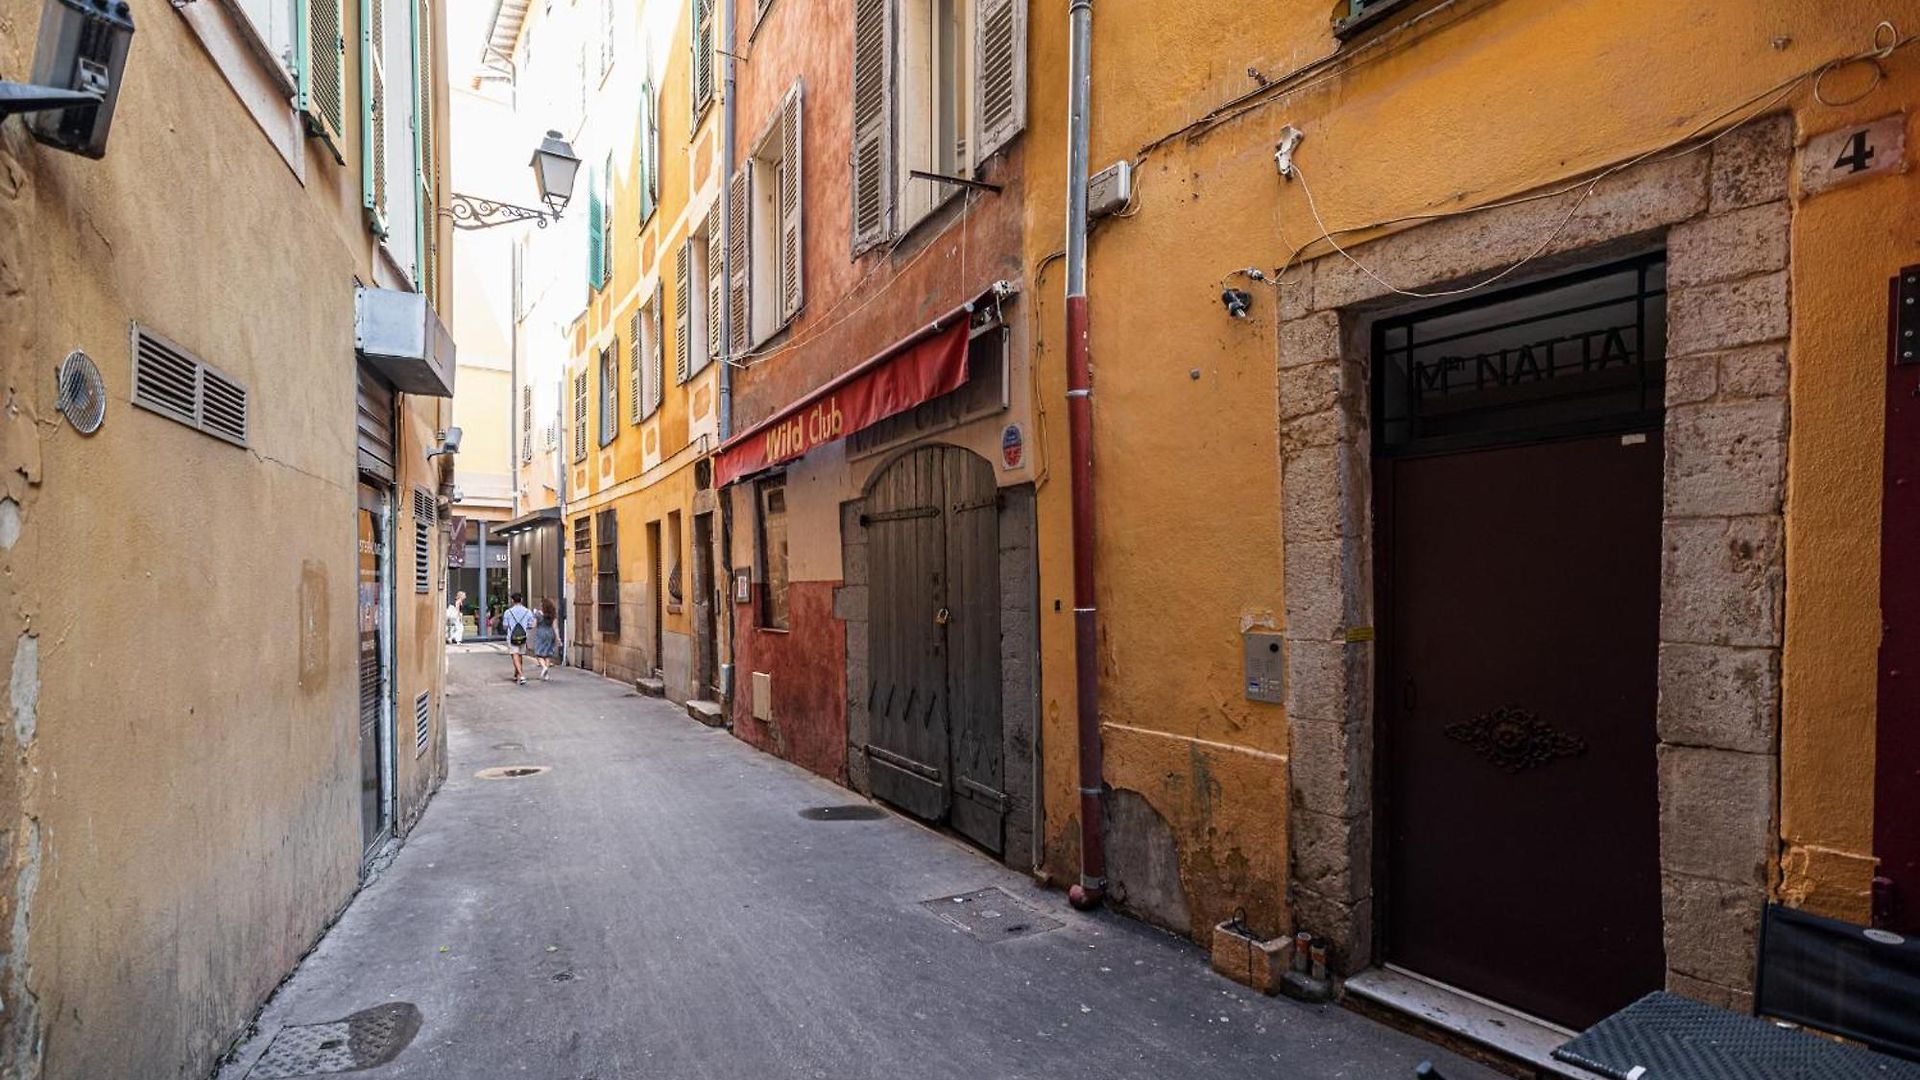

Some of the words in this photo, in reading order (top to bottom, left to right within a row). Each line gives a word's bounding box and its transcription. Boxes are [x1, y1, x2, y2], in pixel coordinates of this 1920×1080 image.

[1832, 128, 1874, 175] 4
[766, 414, 804, 464] Wild
[809, 396, 843, 445] Club
